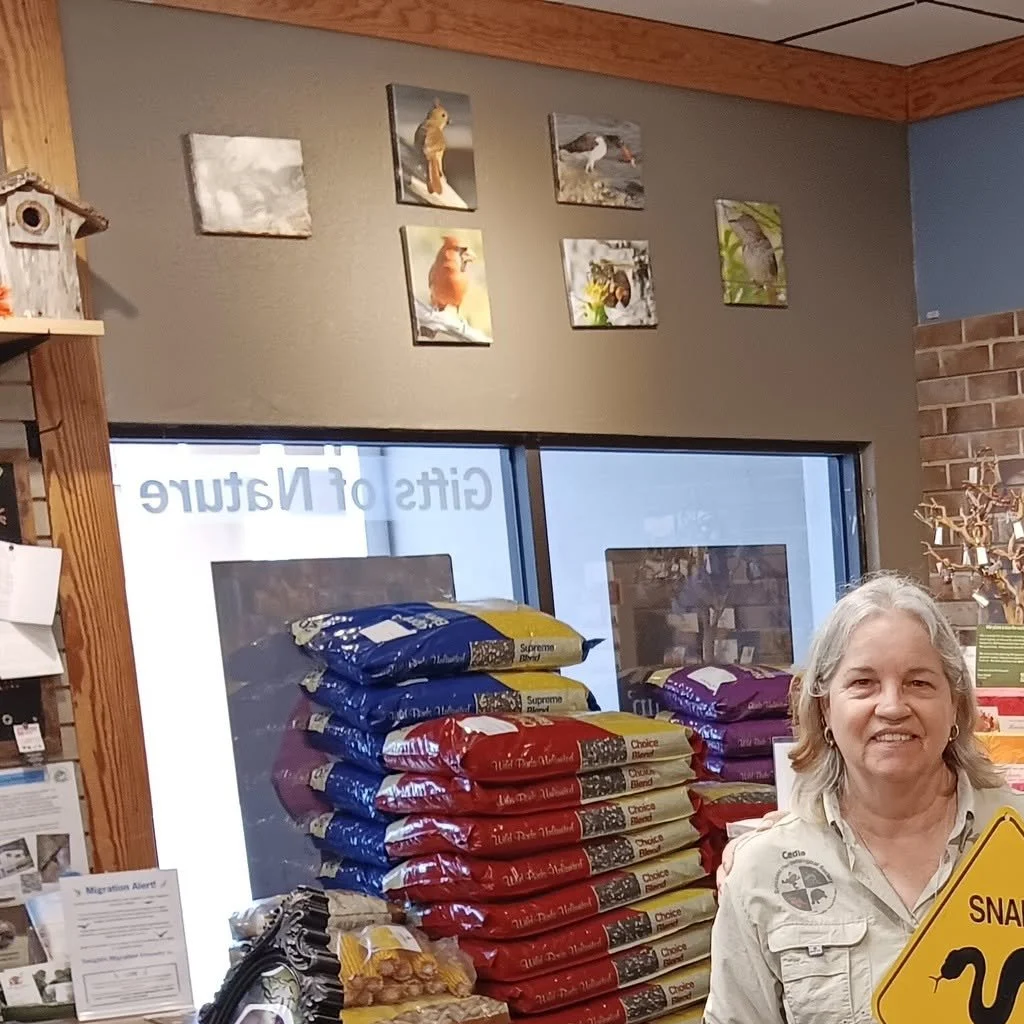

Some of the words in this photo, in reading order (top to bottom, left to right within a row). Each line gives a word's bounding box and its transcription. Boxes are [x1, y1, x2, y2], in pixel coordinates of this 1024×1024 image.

[520, 643, 555, 655] Supreme
[527, 695, 563, 706] Supreme
[631, 739, 659, 750] Choice
[630, 778, 653, 789] Blend
[628, 802, 656, 814] Choice
[635, 833, 664, 847] Choice
[641, 868, 669, 882] Choice
[85, 883, 130, 896] Migration
[655, 906, 682, 921] Choice
[661, 942, 687, 957] Choice
[668, 980, 695, 995] Choice
